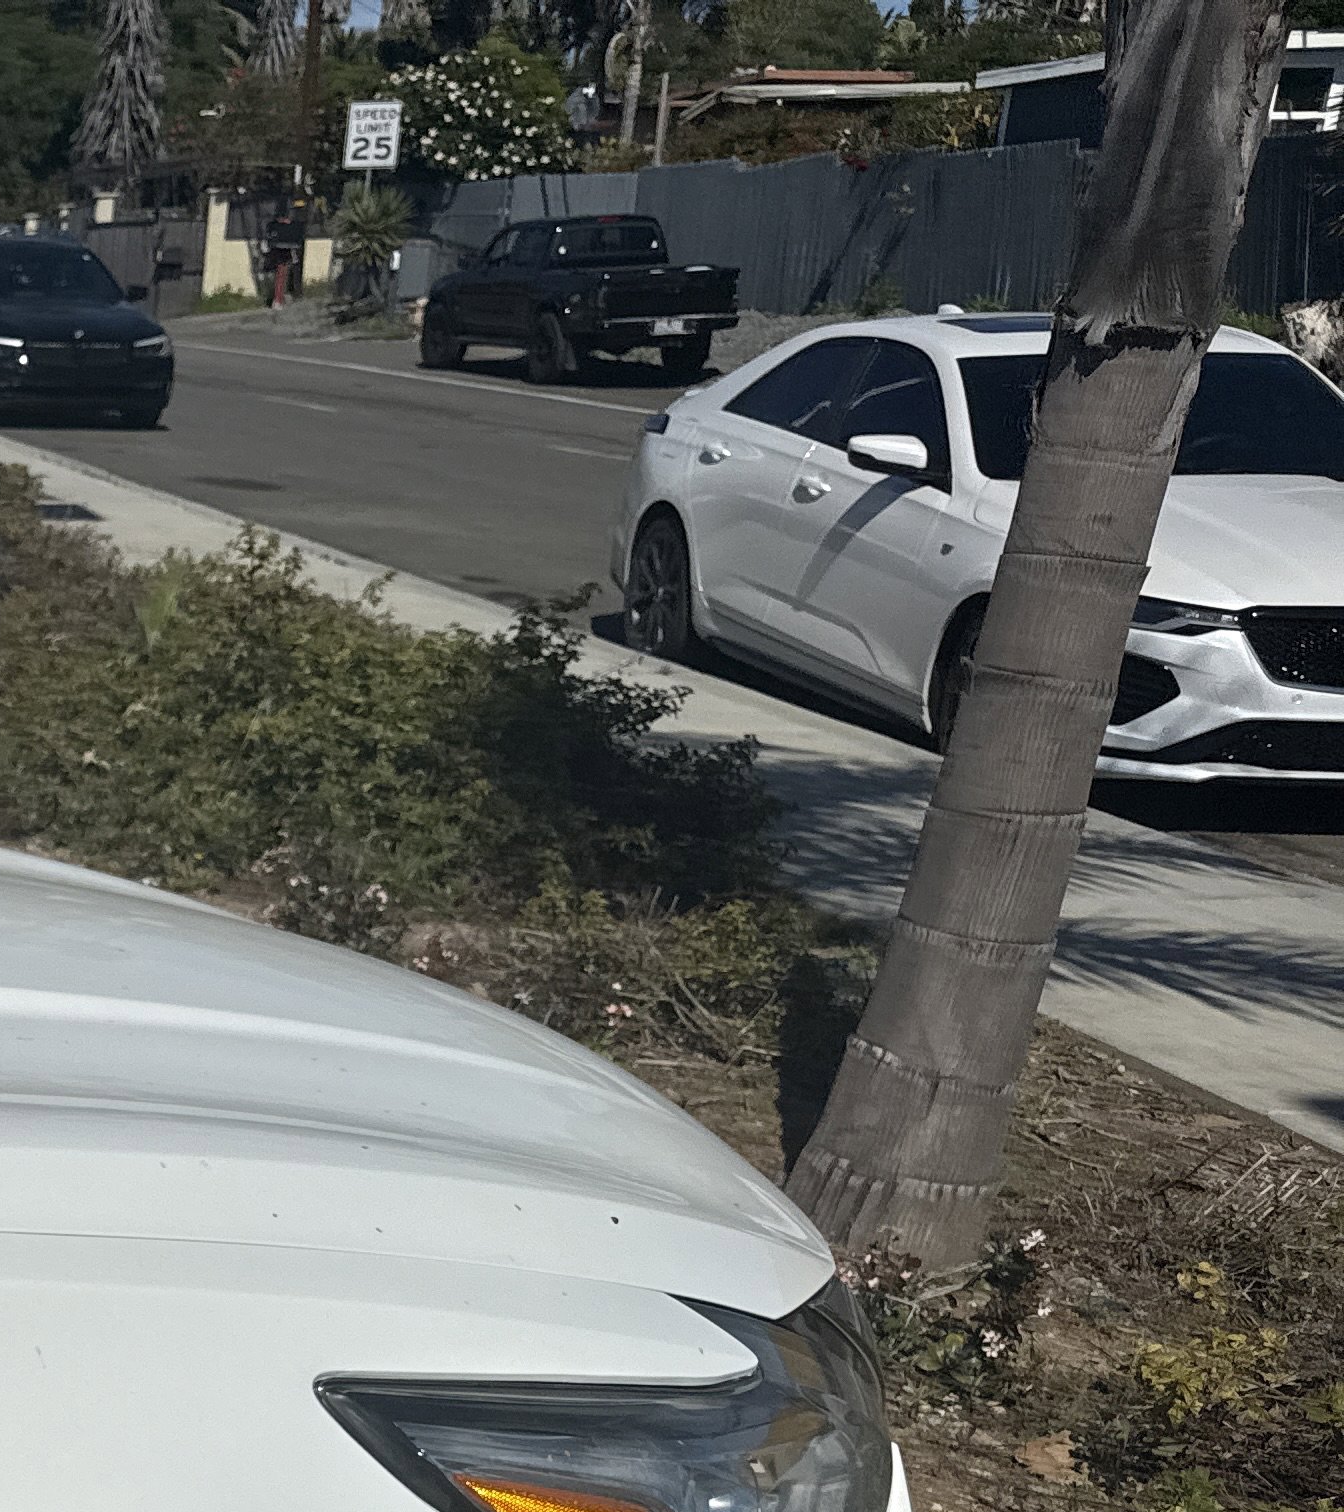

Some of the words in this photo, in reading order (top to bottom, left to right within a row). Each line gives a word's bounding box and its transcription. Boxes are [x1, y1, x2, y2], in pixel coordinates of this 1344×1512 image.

[353, 108, 398, 120] SPEED
[355, 123, 392, 134] LIMIT
[351, 136, 393, 161] 25
